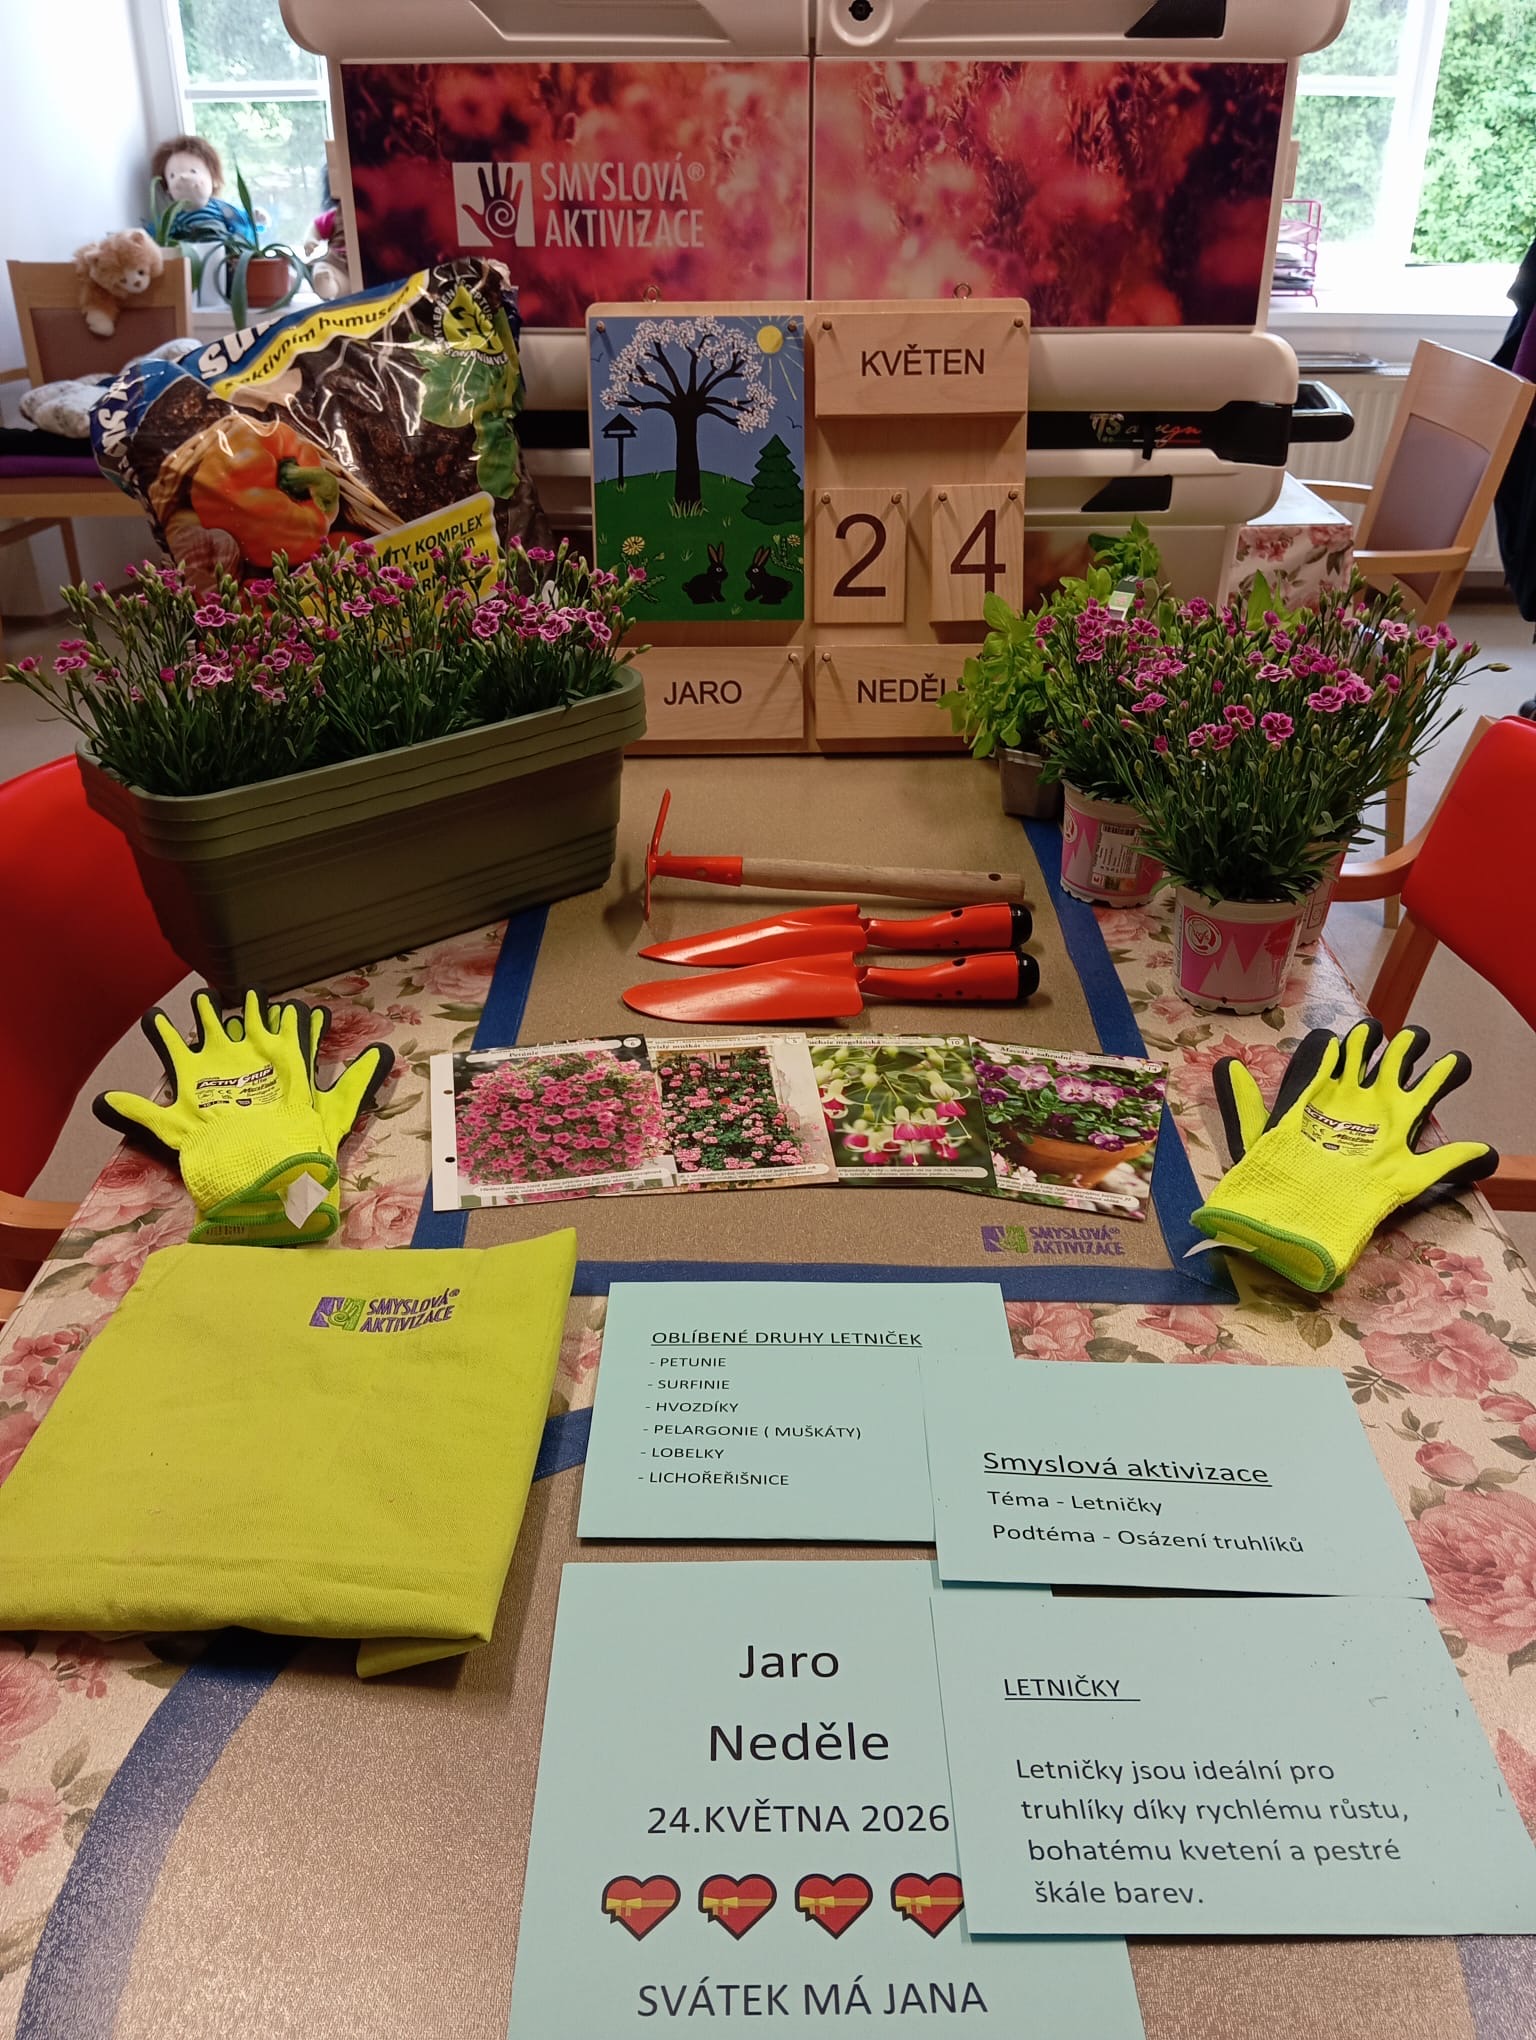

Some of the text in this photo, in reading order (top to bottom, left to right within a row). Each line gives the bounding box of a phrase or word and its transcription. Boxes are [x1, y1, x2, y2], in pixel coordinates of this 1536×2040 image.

[544, 208, 705, 249] AKTIVIZACE
[861, 343, 985, 377] KVĚTEN
[415, 512, 484, 555] KOMPLEX
[832, 508, 1007, 598] 2 4
[663, 679, 742, 706] JARO
[857, 672, 966, 704] NEDĚL
[1033, 1240, 1125, 1255] AKTIVIZACE
[359, 1304, 456, 1333] AKTIVIZACE
[652, 1328, 922, 1345] OBLÍBENÉ DRUHY LETNIČEK
[660, 1357, 727, 1368] PETUNIE
[657, 1379, 730, 1390] SURFINIE
[656, 1400, 739, 1413] HVOZDÍKY
[654, 1424, 759, 1437] PELARGONIE
[775, 1424, 861, 1441] MUŠKÁTY)
[651, 1447, 725, 1460] LOBELKY
[649, 1470, 790, 1486] LICHOŘEŘIŠNICE
[983, 1452, 1269, 1483] Smyslová aktivizace
[986, 1490, 1049, 1508] Téma
[1071, 1495, 1162, 1517] Letničky
[992, 1524, 1096, 1543] Podtéma
[1117, 1530, 1208, 1549] Osázení
[1212, 1535, 1304, 1553] truhlíků
[738, 1644, 839, 1679] Jaro
[1003, 1674, 1120, 1698] LETNIČKY
[710, 1721, 889, 1762] Neděle
[1016, 1759, 1335, 1785] Letničky jsou ideální pro
[647, 1797, 950, 1834] 24.KVĚTNA 2026
[1020, 1798, 1408, 1825] truhlíky díky rychlému růstu,
[1027, 1838, 1401, 1867] bohatému kvetení a pestré
[1034, 1880, 1204, 1904] škále barev.
[637, 1974, 989, 2017] SVÁTEK MÁ JANA
